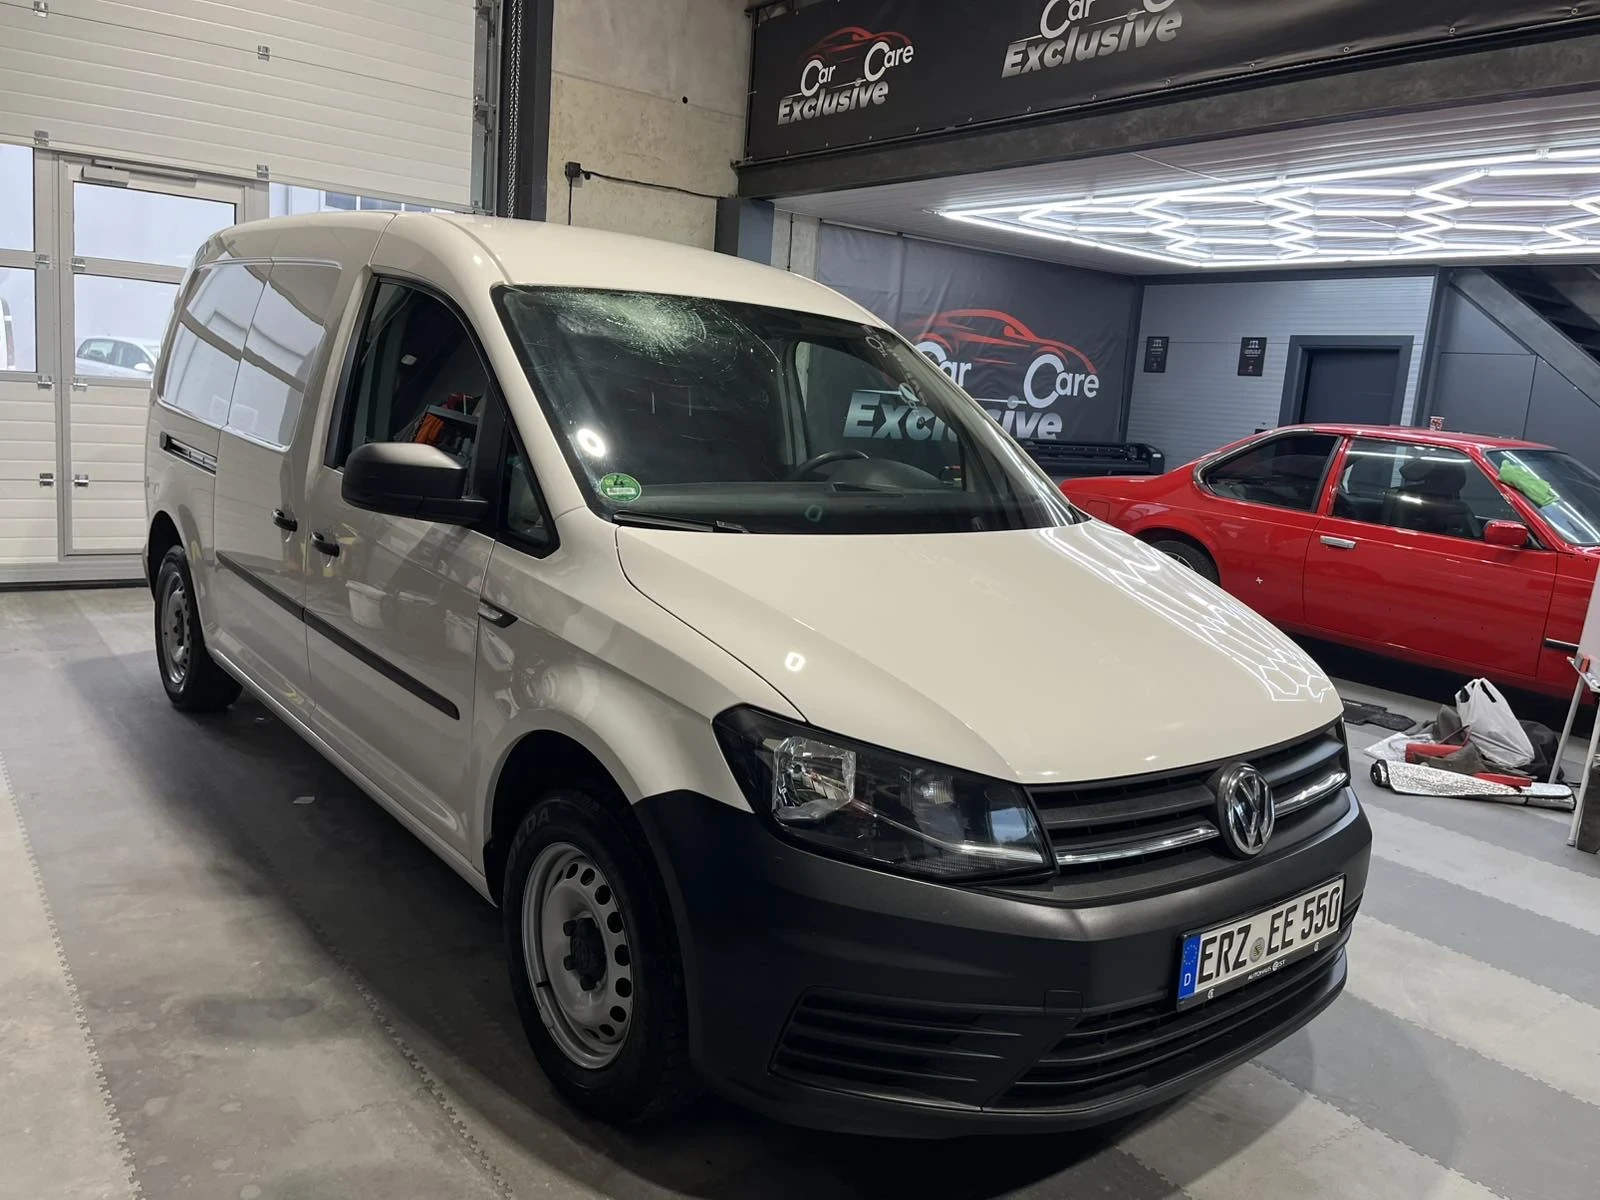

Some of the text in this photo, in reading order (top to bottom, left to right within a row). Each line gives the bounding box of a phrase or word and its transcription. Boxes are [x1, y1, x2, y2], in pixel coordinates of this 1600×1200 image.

[800, 41, 914, 96] Car Care
[1001, 9, 1182, 78] Exclusive
[777, 78, 889, 125] Exclusive
[1023, 354, 1100, 408] Care
[843, 392, 1063, 441] Exclive
[1183, 886, 1341, 987] D ERZ EE 550
